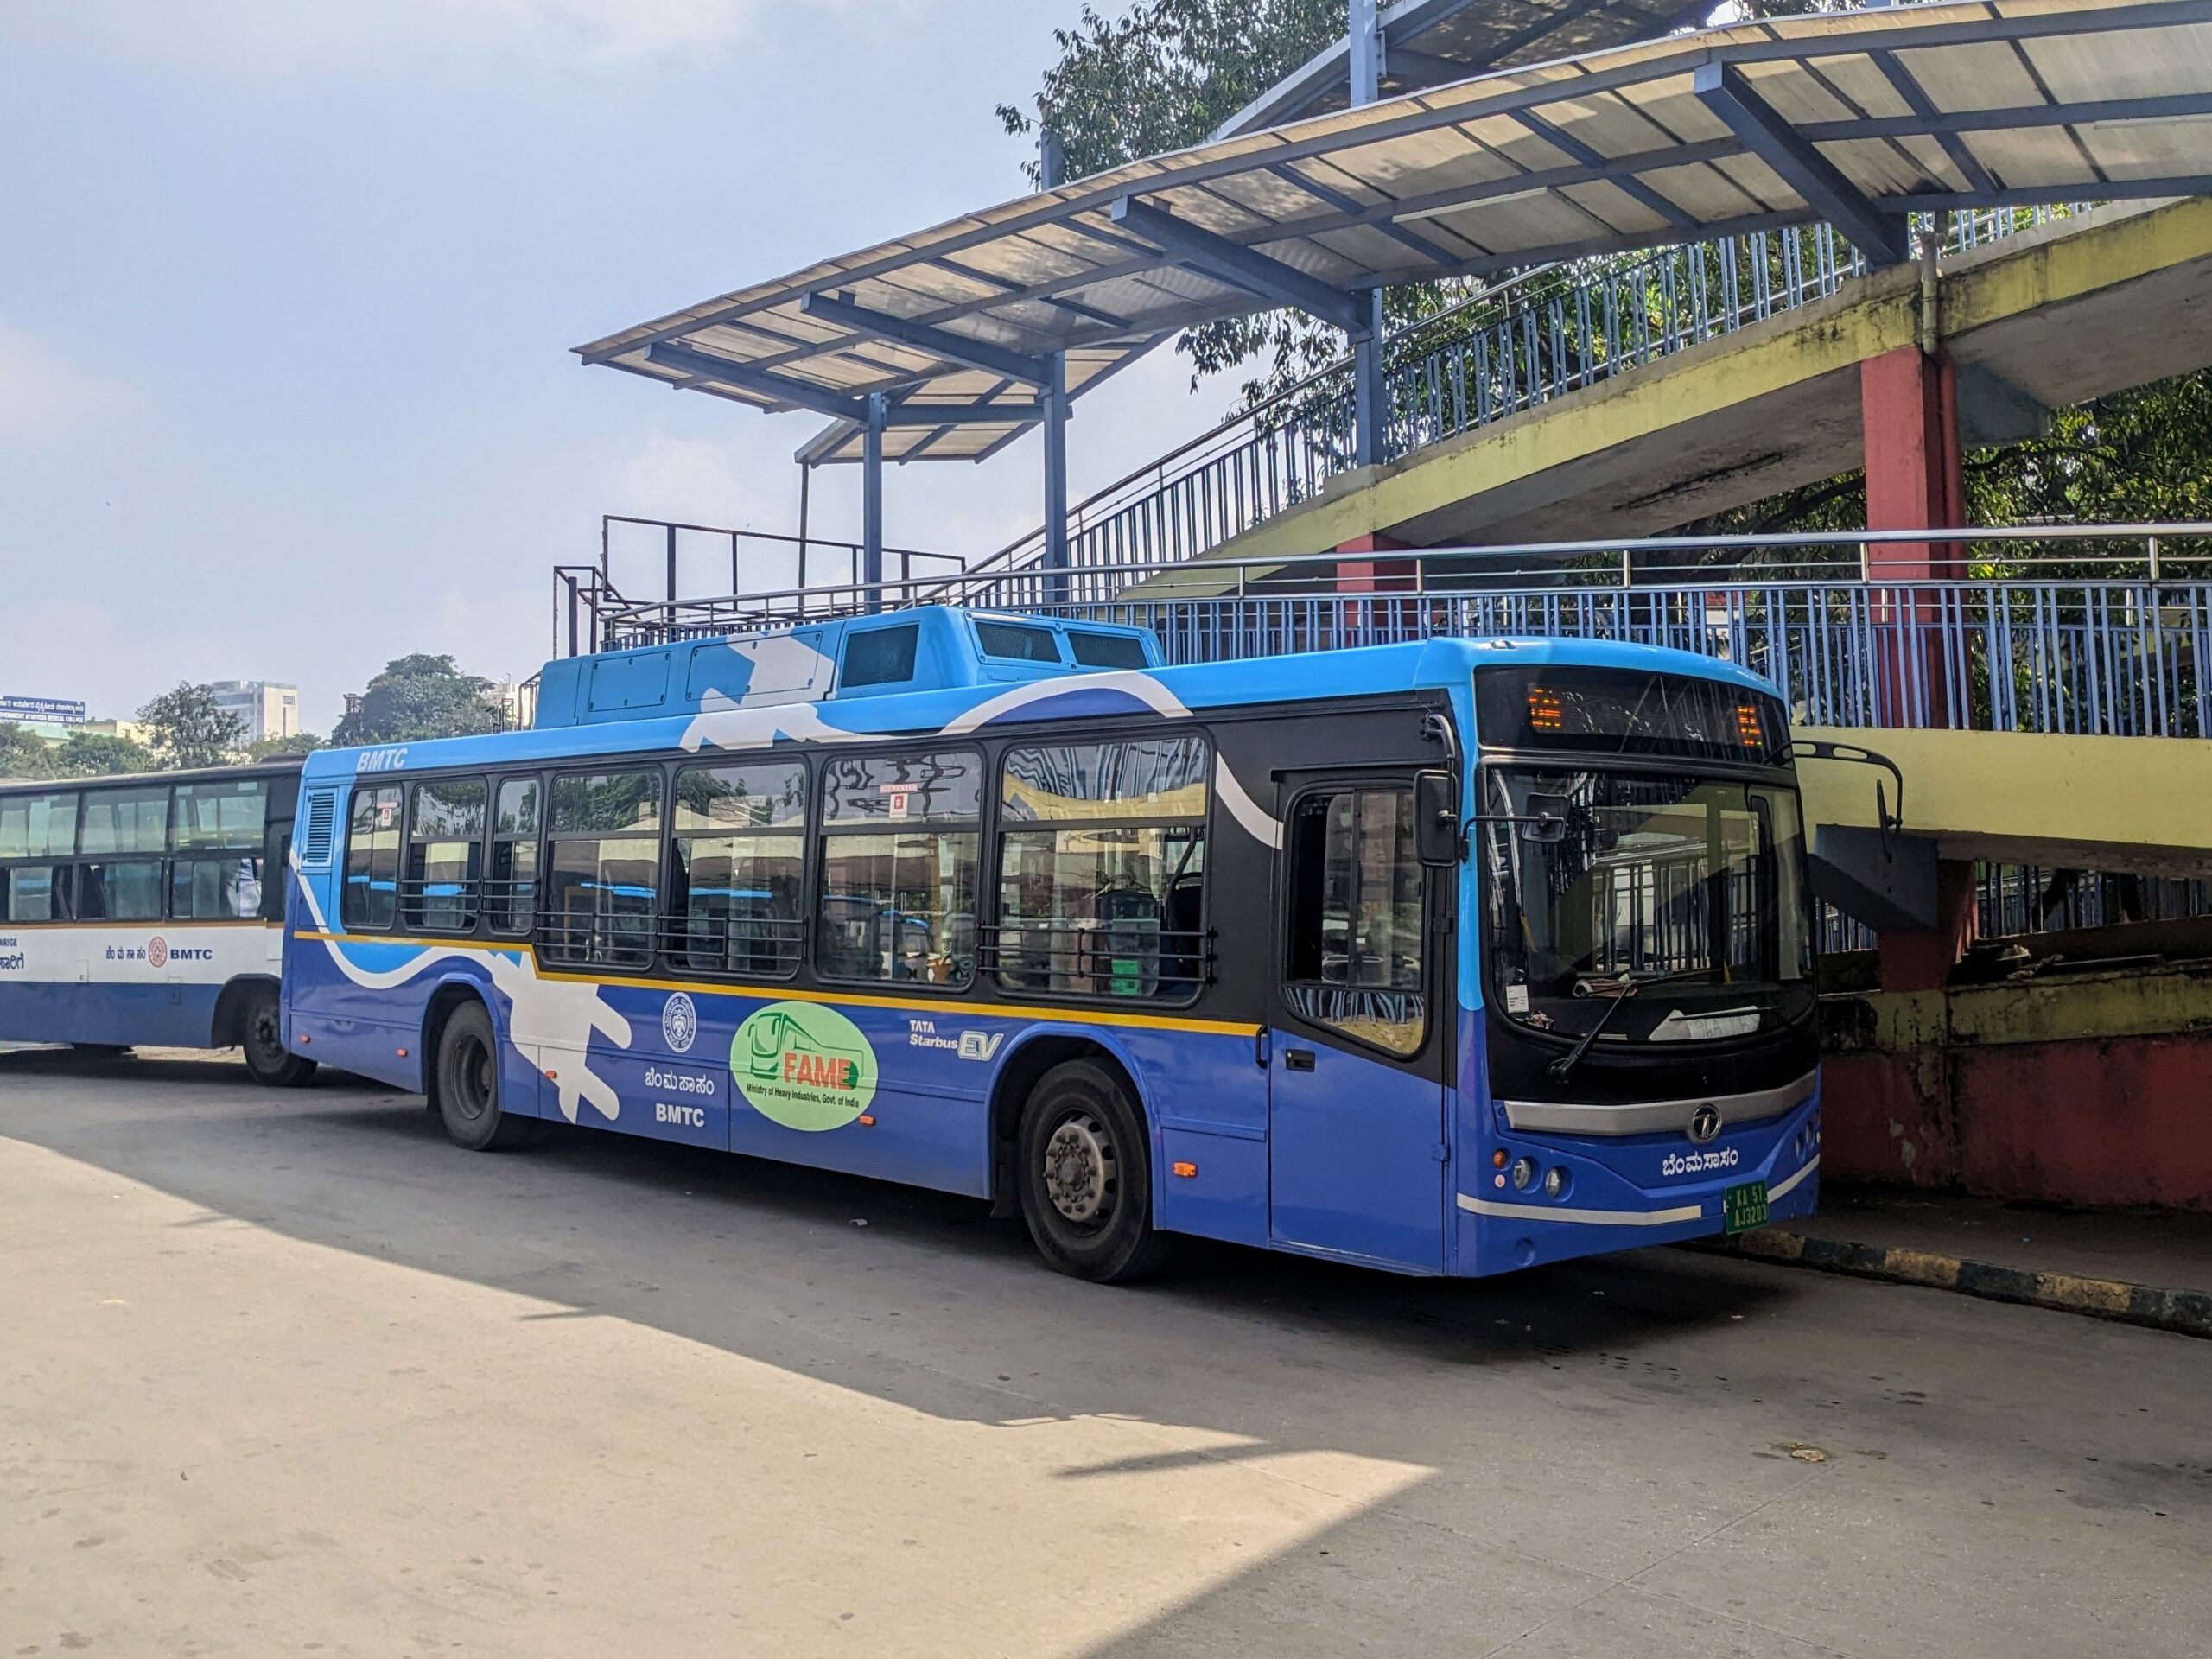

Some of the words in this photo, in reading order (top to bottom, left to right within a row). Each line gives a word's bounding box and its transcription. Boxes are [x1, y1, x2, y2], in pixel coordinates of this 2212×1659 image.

[356, 747, 408, 772] BMTC
[170, 949, 213, 960] BMTC
[910, 1020, 935, 1033] TATA
[910, 1033, 958, 1050] Starbus
[957, 1030, 1004, 1061] EV
[784, 1052, 851, 1090] FAME
[747, 1083, 767, 1097] Ministry
[768, 1086, 774, 1096] of
[775, 1087, 791, 1101] Heavy
[792, 1089, 821, 1104] Industries,
[822, 1093, 837, 1105] Govt.
[838, 1096, 844, 1105] of
[845, 1096, 860, 1109] India
[656, 1103, 705, 1128] BMTC
[1662, 1146, 1738, 1176] ಬೆಂಮಸಾಸಂ
[1737, 1188, 1748, 1208] KA
[1752, 1184, 1763, 1204] 51
[1735, 1204, 1767, 1228] AJ3203
